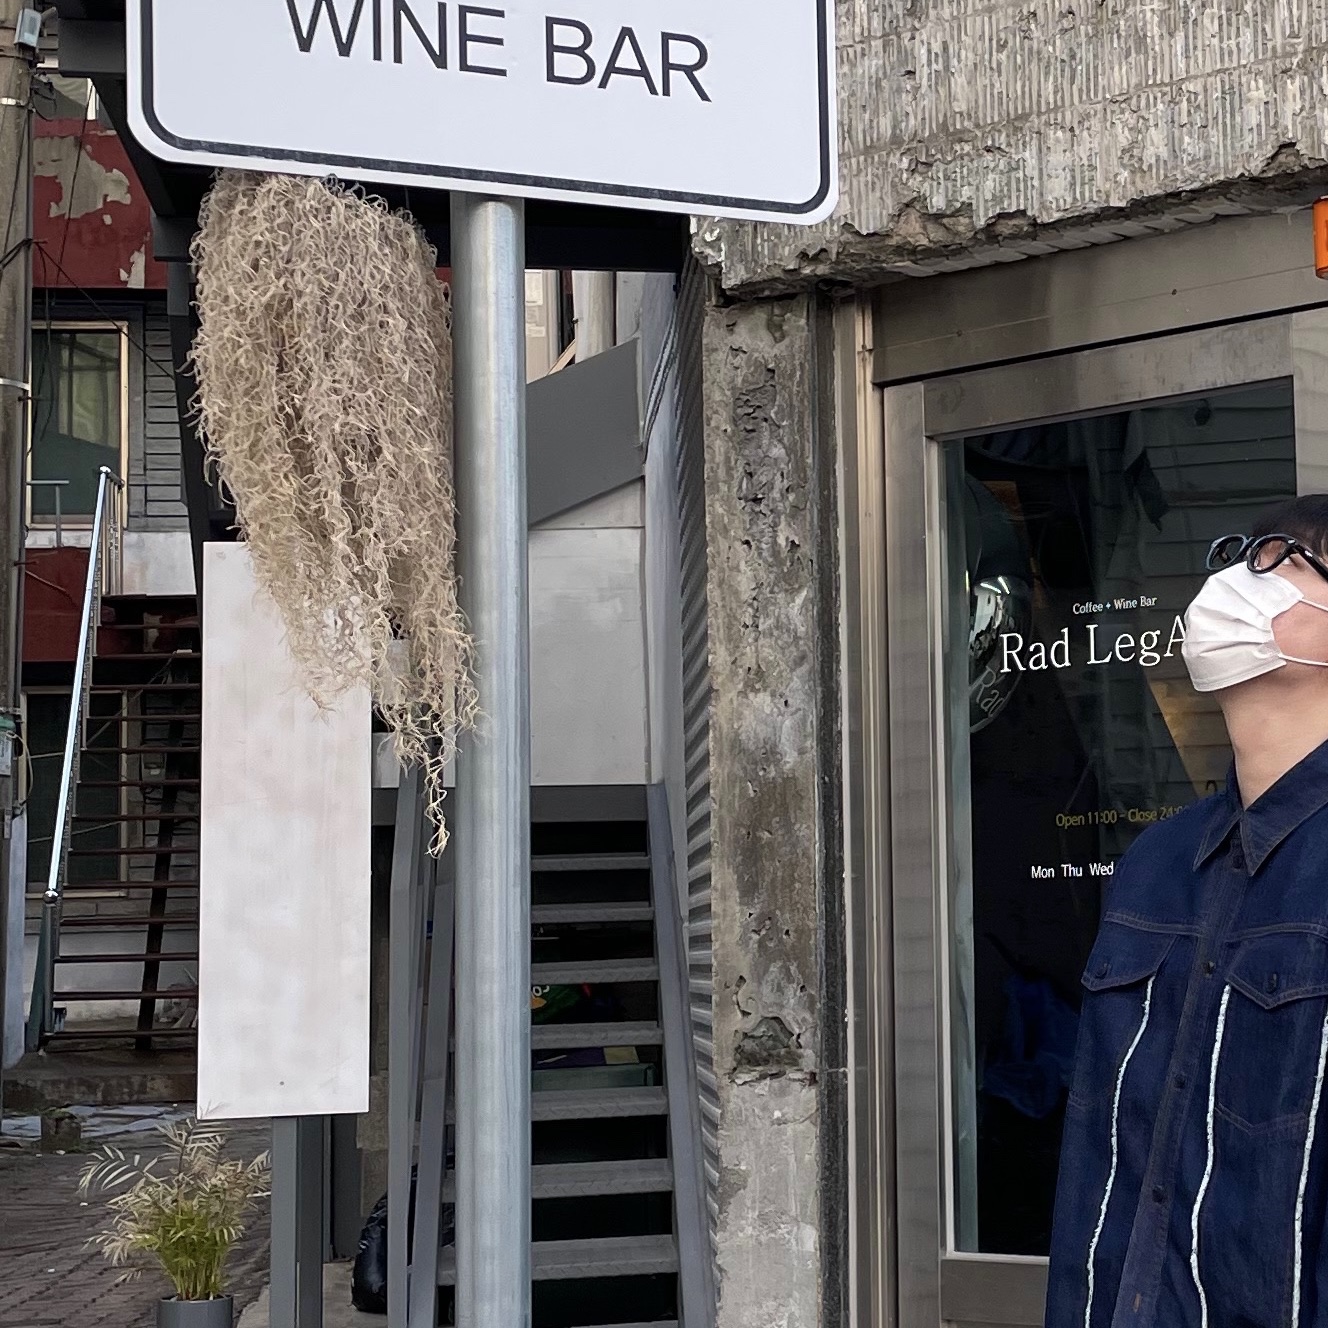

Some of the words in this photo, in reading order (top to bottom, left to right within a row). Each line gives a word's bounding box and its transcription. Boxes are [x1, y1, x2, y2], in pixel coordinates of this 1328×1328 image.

[284, 0, 508, 78] WINE
[545, 15, 713, 103] BAR
[1072, 601, 1104, 615] Coffee
[1113, 598, 1137, 610] Wine
[1140, 596, 1158, 607] Bar
[1000, 626, 1072, 673] Rad
[1086, 614, 1187, 667] LegA
[1055, 813, 1085, 829] Open
[1088, 810, 1118, 824] 11:00
[1128, 808, 1157, 823] Close
[1031, 865, 1055, 879] Mon
[1061, 863, 1082, 877] Thu
[1089, 860, 1114, 876] Wed
